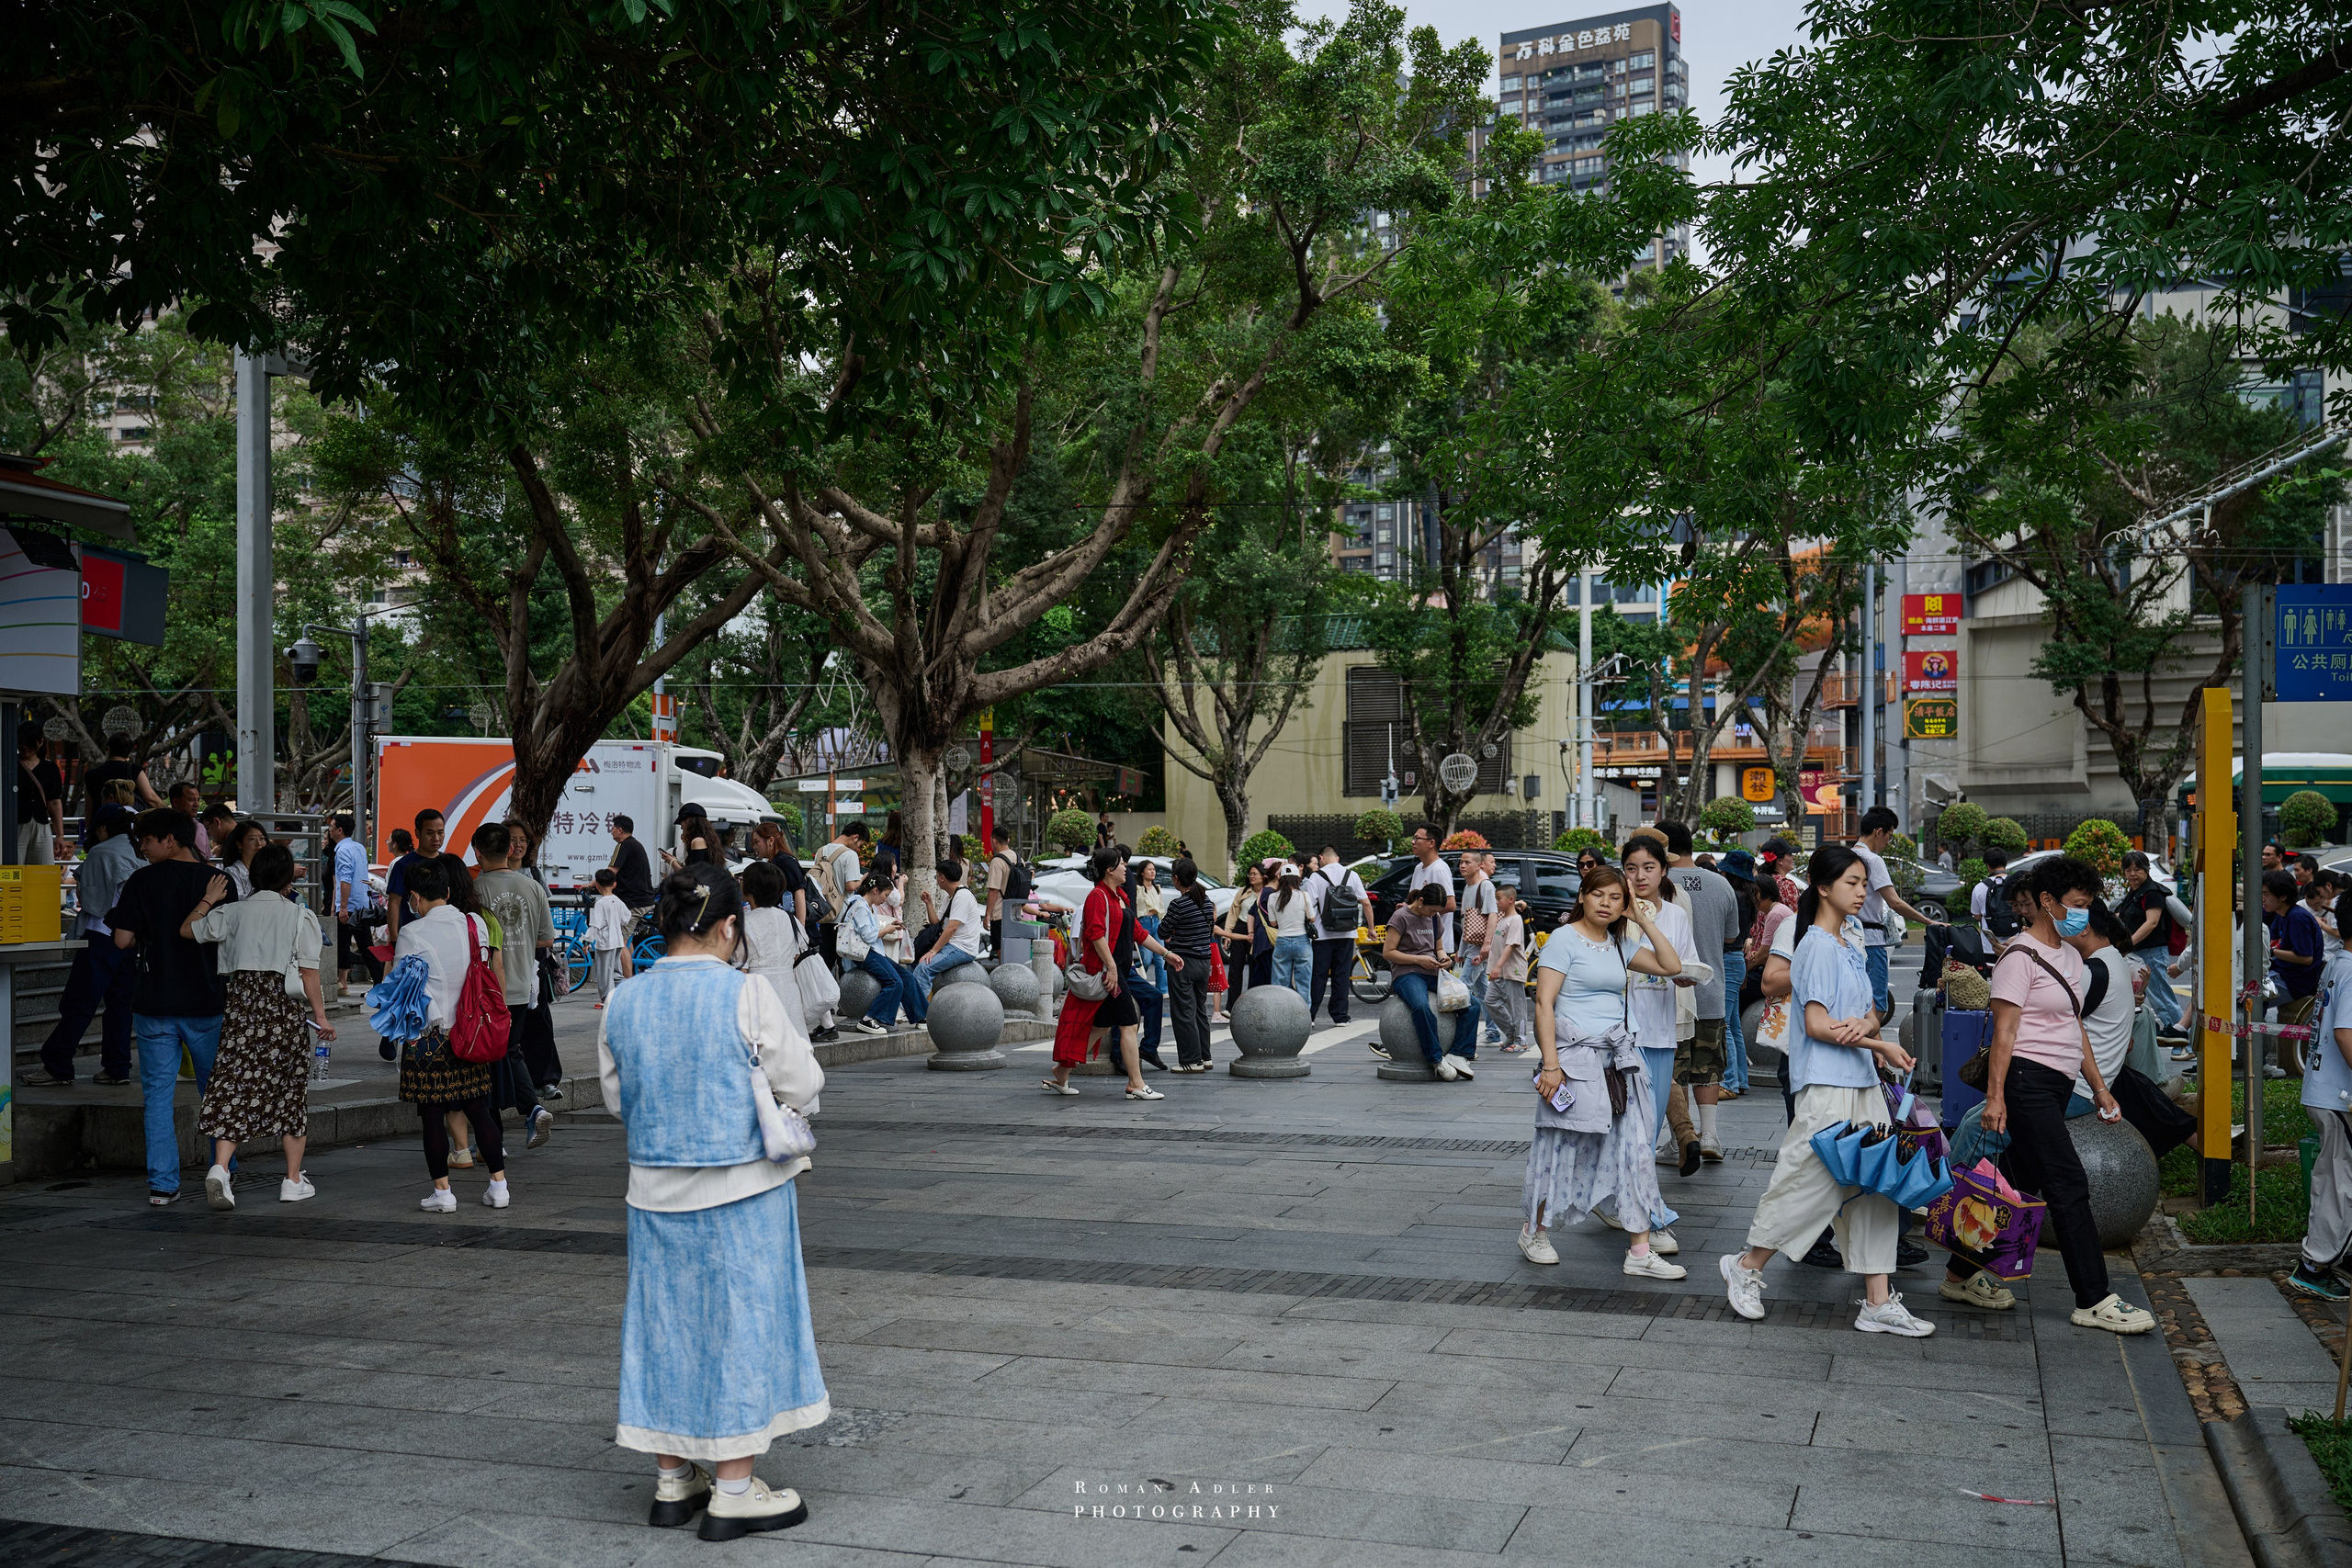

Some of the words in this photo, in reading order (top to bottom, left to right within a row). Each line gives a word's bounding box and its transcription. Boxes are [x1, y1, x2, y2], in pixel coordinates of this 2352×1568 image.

[1516, 22, 1632, 61] 万科金色荔苑
[2292, 653, 2352, 671] 公共厕
[983, 741, 990, 750] A
[515, 894, 528, 910] WALK
